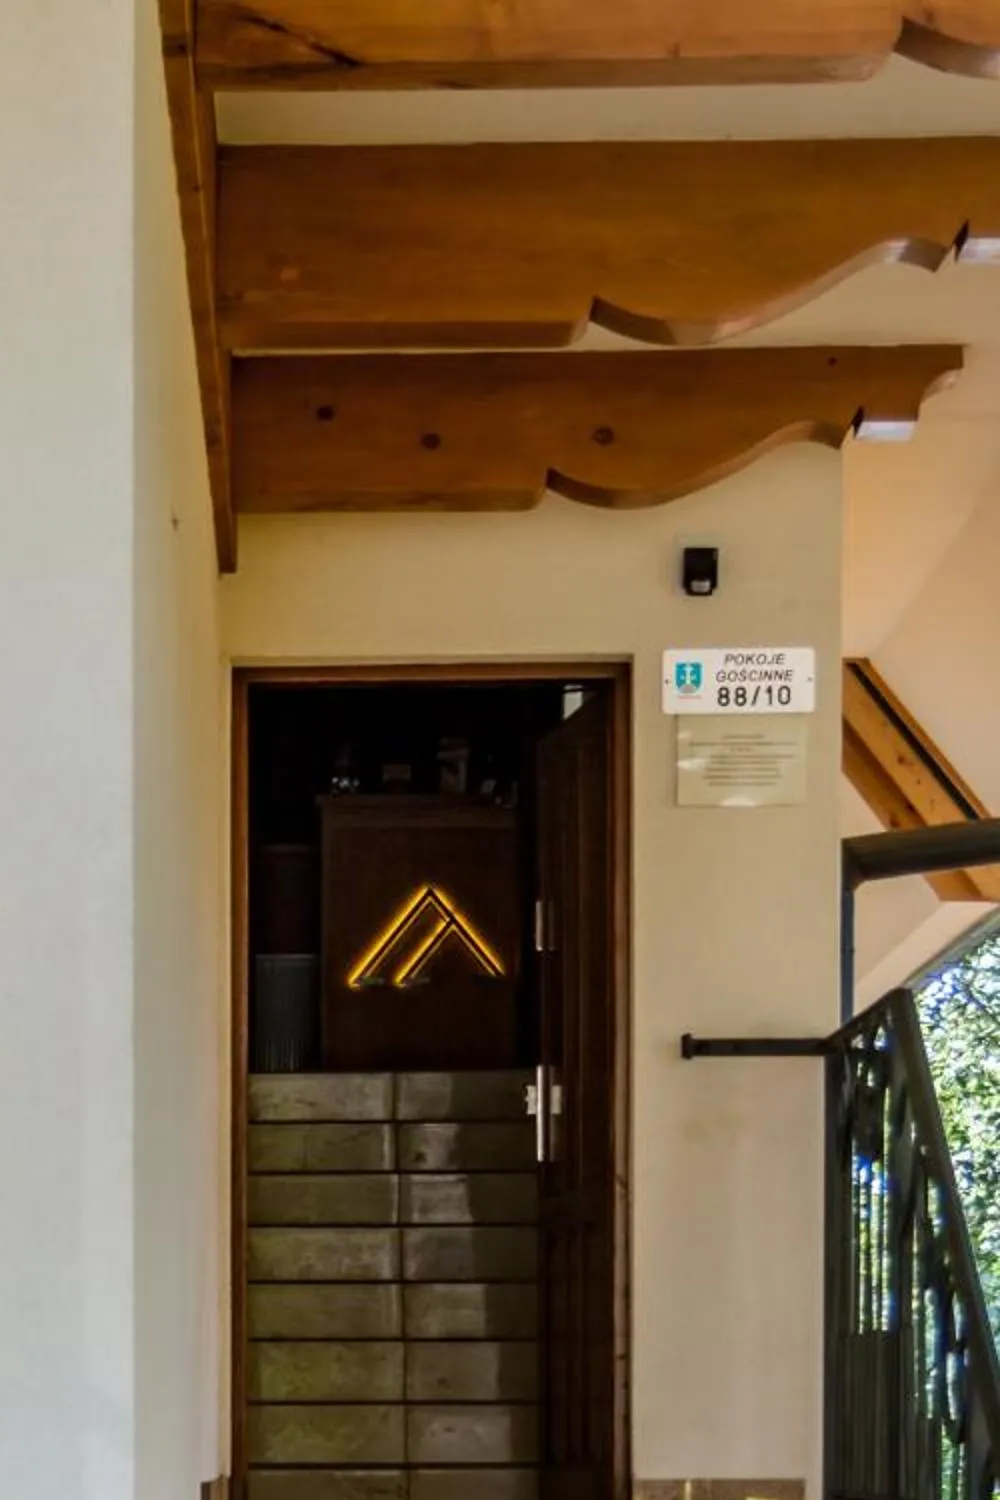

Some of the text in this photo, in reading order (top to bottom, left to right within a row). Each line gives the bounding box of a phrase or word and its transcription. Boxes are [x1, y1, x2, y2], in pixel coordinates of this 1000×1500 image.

[724, 653, 786, 665] POKOJE
[715, 668, 794, 682] GOŚCINNE
[717, 685, 792, 706] 88/10
